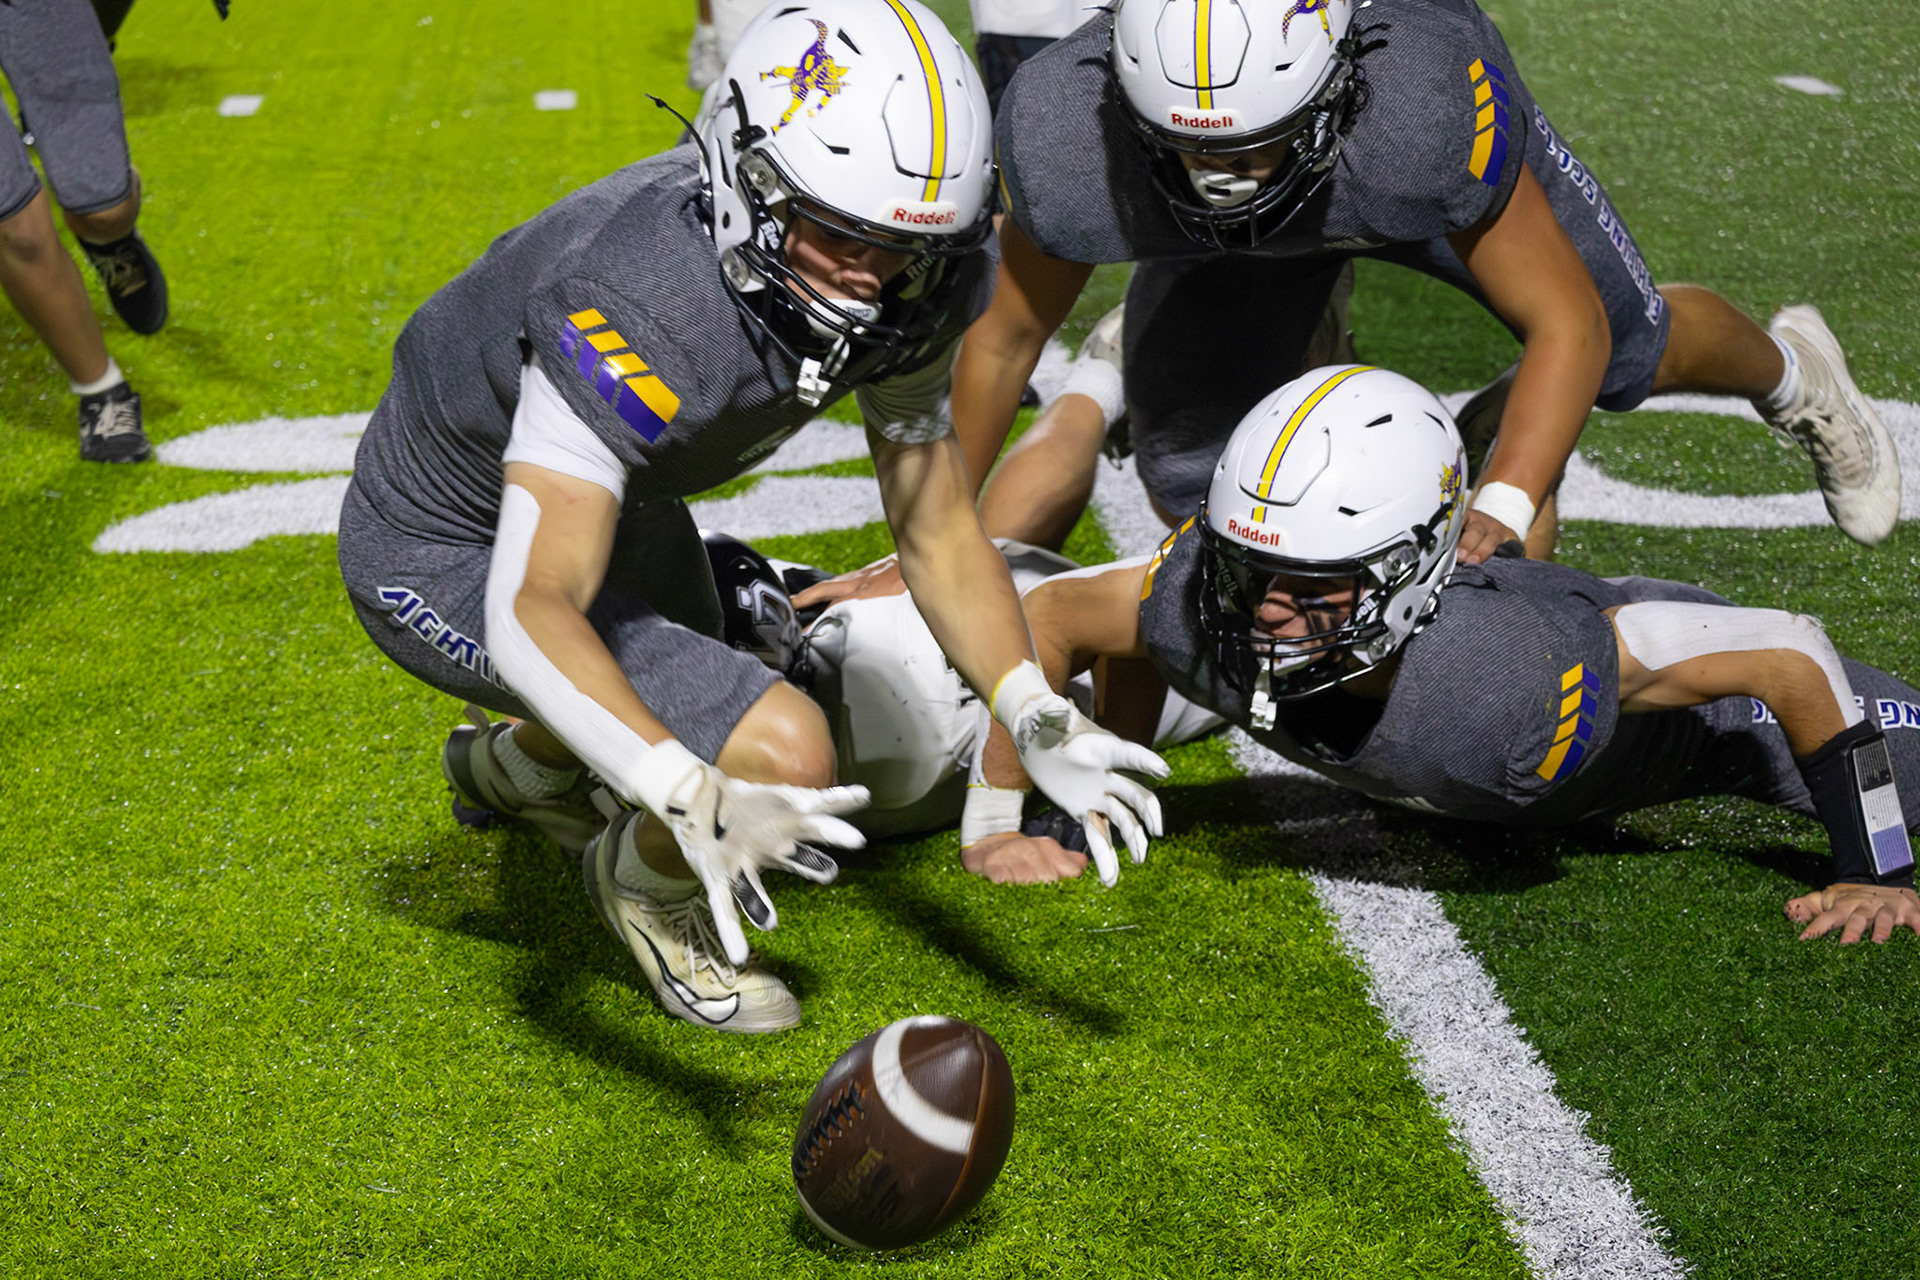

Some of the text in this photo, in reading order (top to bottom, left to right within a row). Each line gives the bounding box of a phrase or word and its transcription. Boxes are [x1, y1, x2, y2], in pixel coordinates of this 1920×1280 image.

[1171, 113, 1233, 129] Riddell
[893, 207, 956, 225] Riddell
[1228, 518, 1281, 547] Riddell
